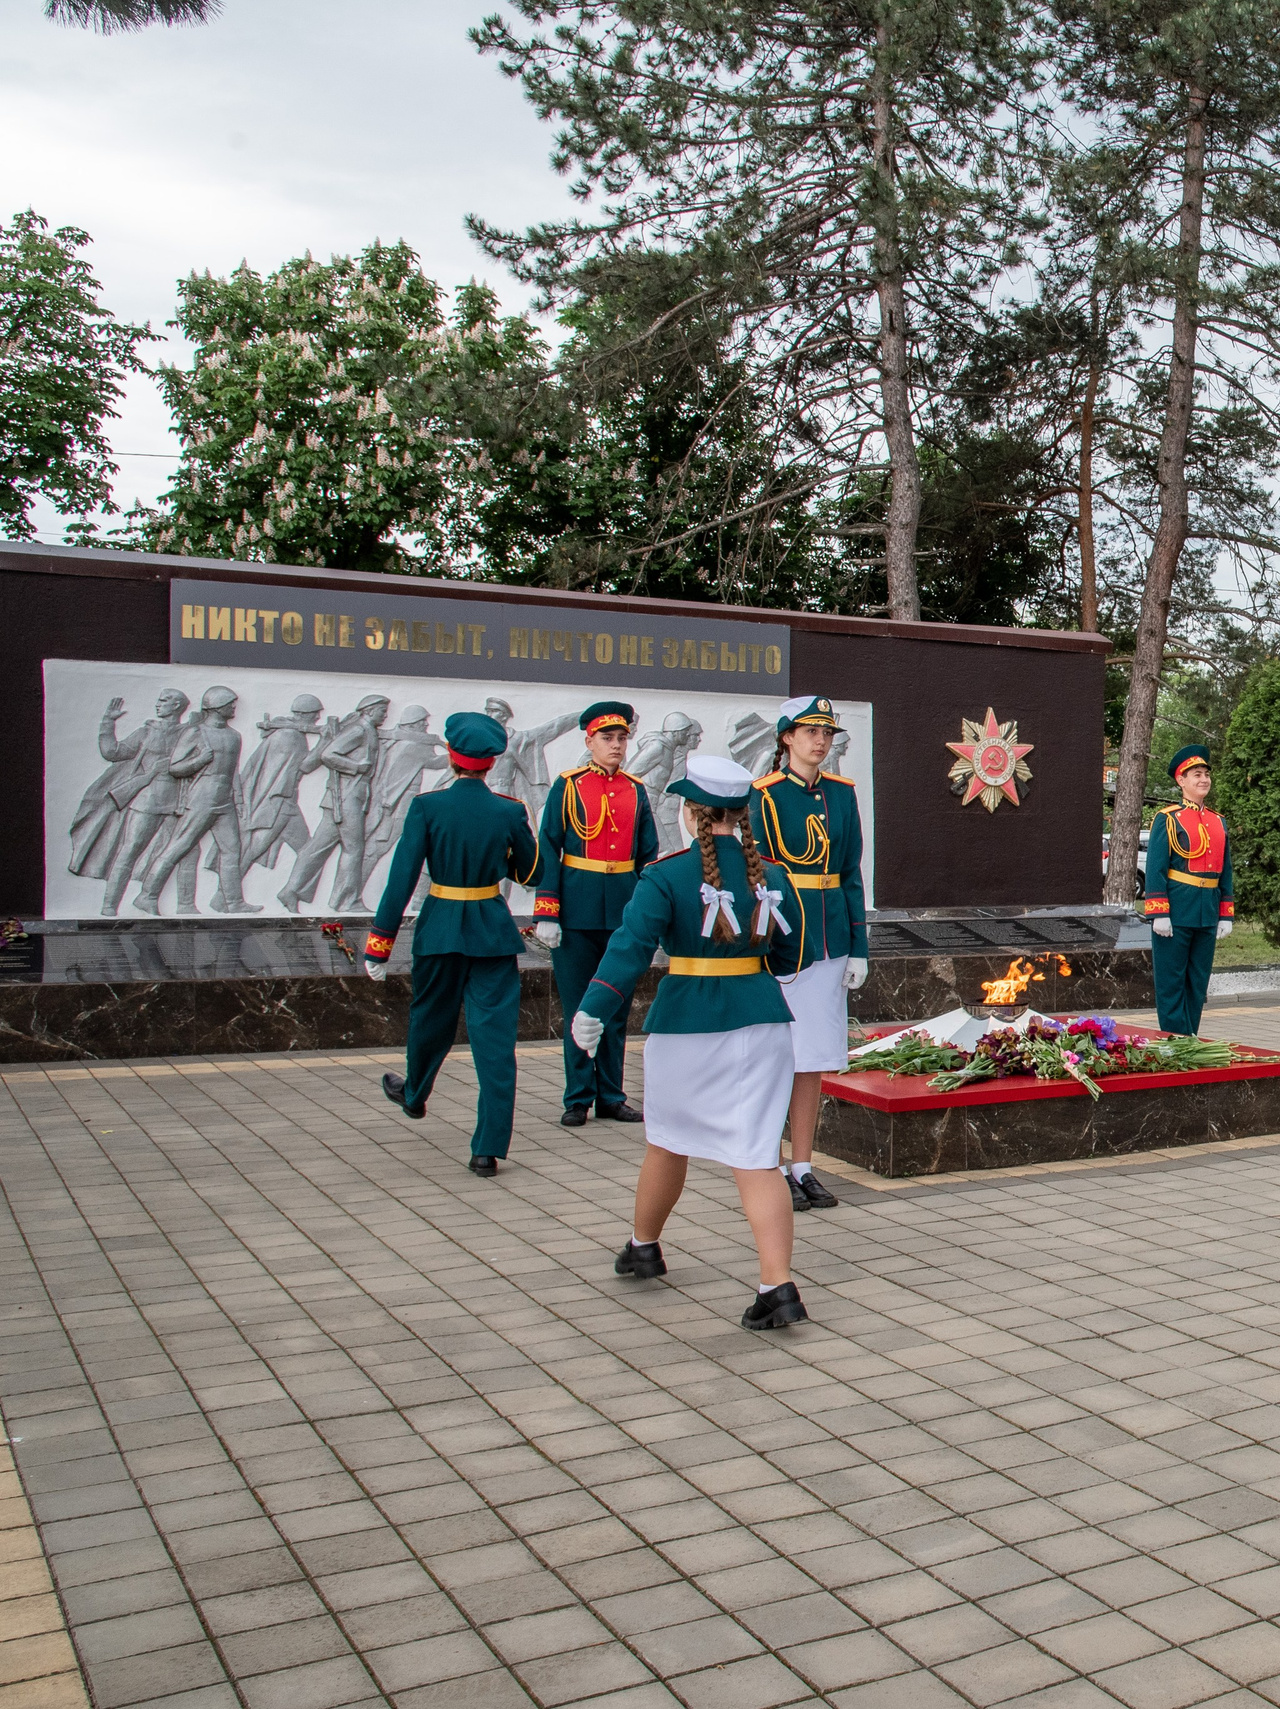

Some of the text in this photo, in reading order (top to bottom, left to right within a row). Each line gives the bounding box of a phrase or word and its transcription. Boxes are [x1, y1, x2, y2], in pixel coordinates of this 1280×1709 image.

[182, 604, 782, 675] НИКТО НЕ ЗАБЫТ, НИЧТО НЕ ЗАБЫТО
